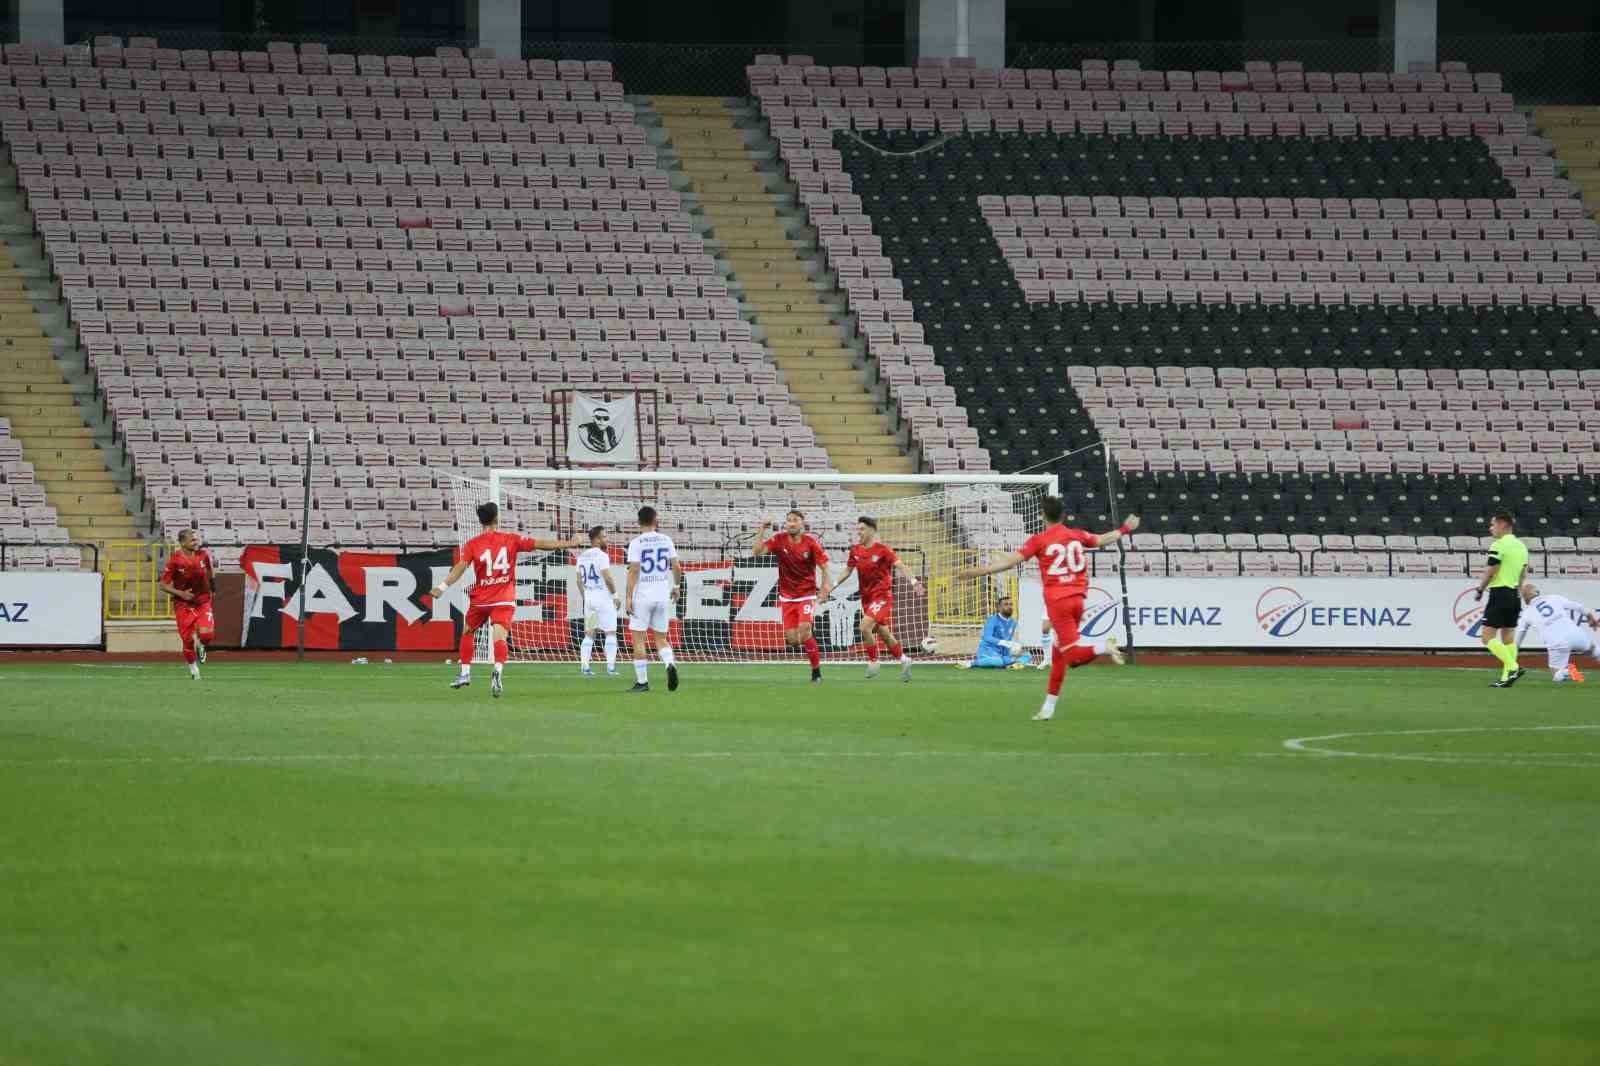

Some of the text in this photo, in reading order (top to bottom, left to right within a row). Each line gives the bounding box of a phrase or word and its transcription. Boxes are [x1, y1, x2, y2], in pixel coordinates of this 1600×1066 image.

[480, 546, 511, 577] 14
[641, 548, 670, 574] 55
[1046, 540, 1087, 576] 20
[579, 563, 600, 584] 94
[1122, 607, 1223, 626] EFENAZ
[1311, 607, 1412, 626] EFENAZ
[1536, 600, 1554, 618] 5
